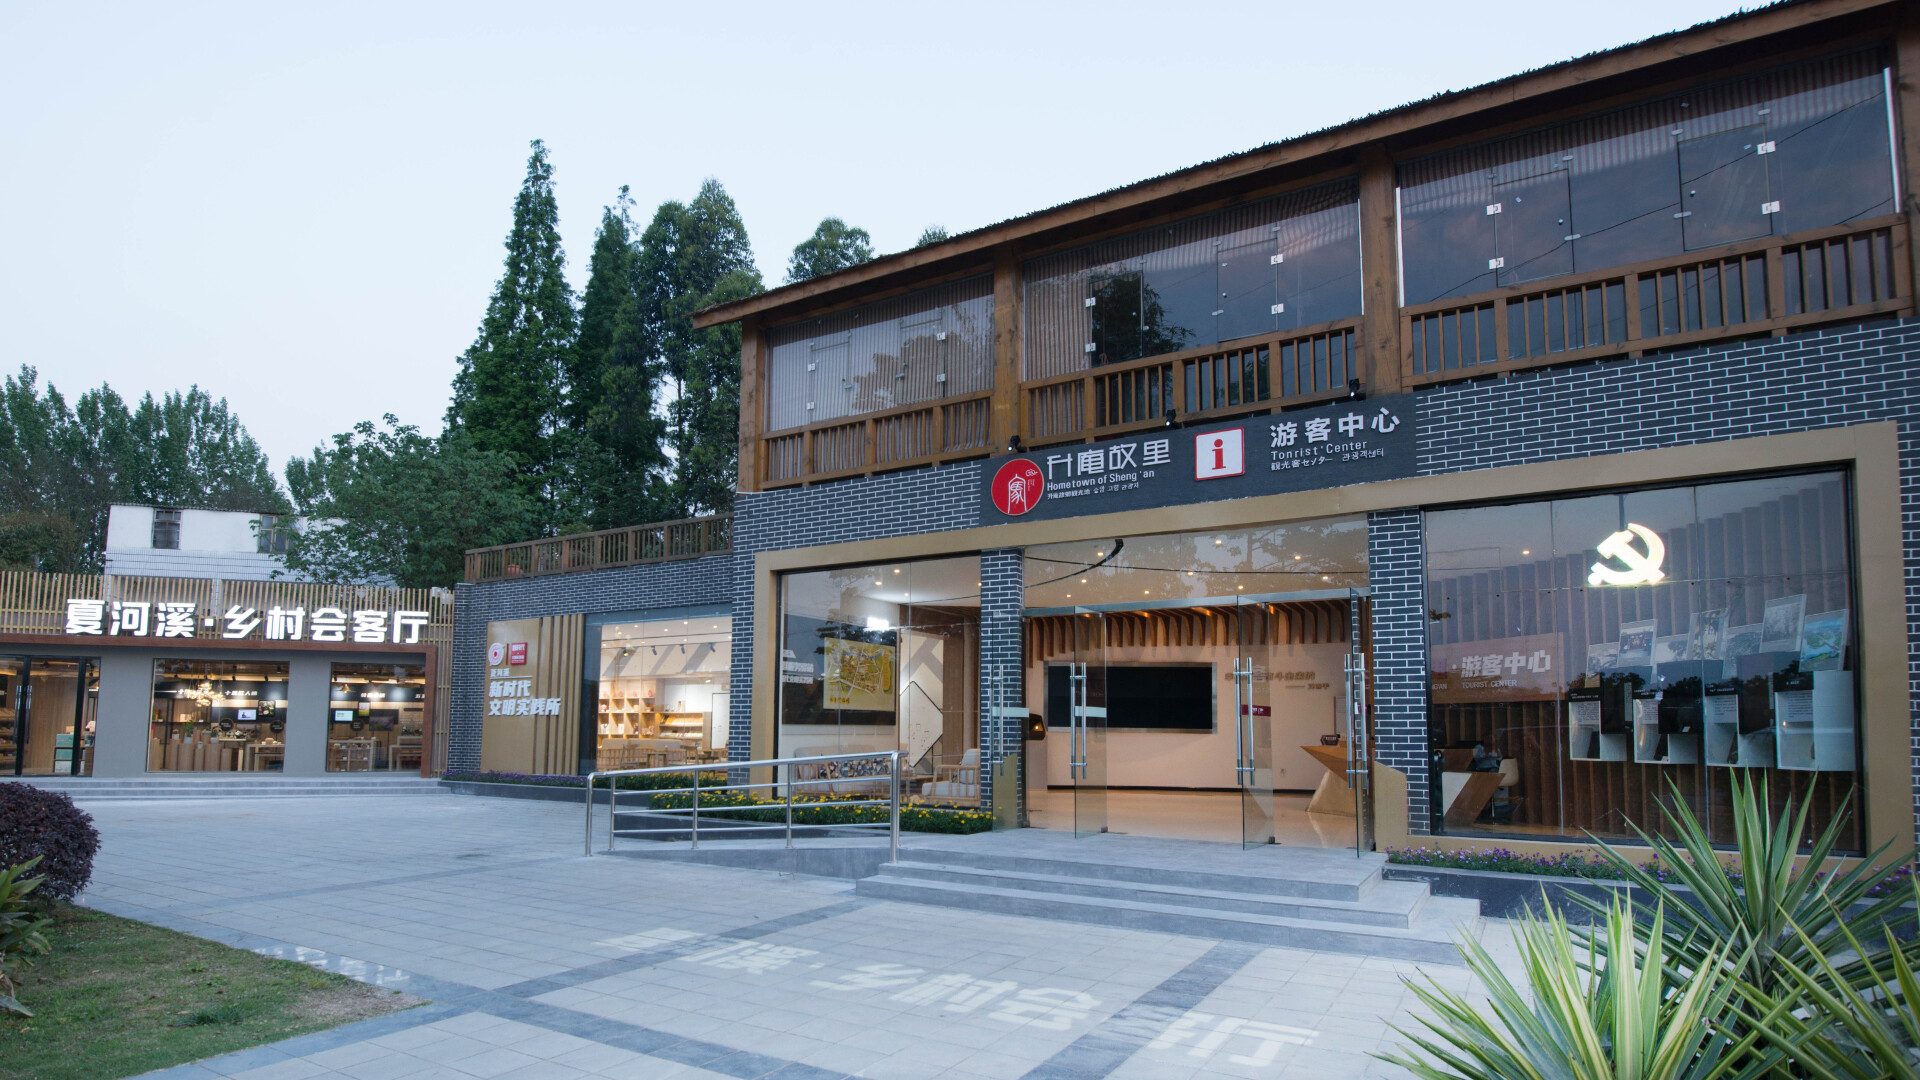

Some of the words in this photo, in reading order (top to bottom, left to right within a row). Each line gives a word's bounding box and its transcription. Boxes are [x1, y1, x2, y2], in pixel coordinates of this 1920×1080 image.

[1270, 407, 1400, 448] 游客中心
[1326, 441, 1367, 454] Center
[1047, 439, 1171, 479] 升庵故里
[1047, 478, 1096, 491] Hometown
[1097, 474, 1107, 484] of
[66, 598, 430, 644] 夏河溪·乡村会客厅
[488, 680, 532, 698] 新时代
[1490, 679, 1518, 688] CENTER
[488, 698, 562, 716] 文明实践所
